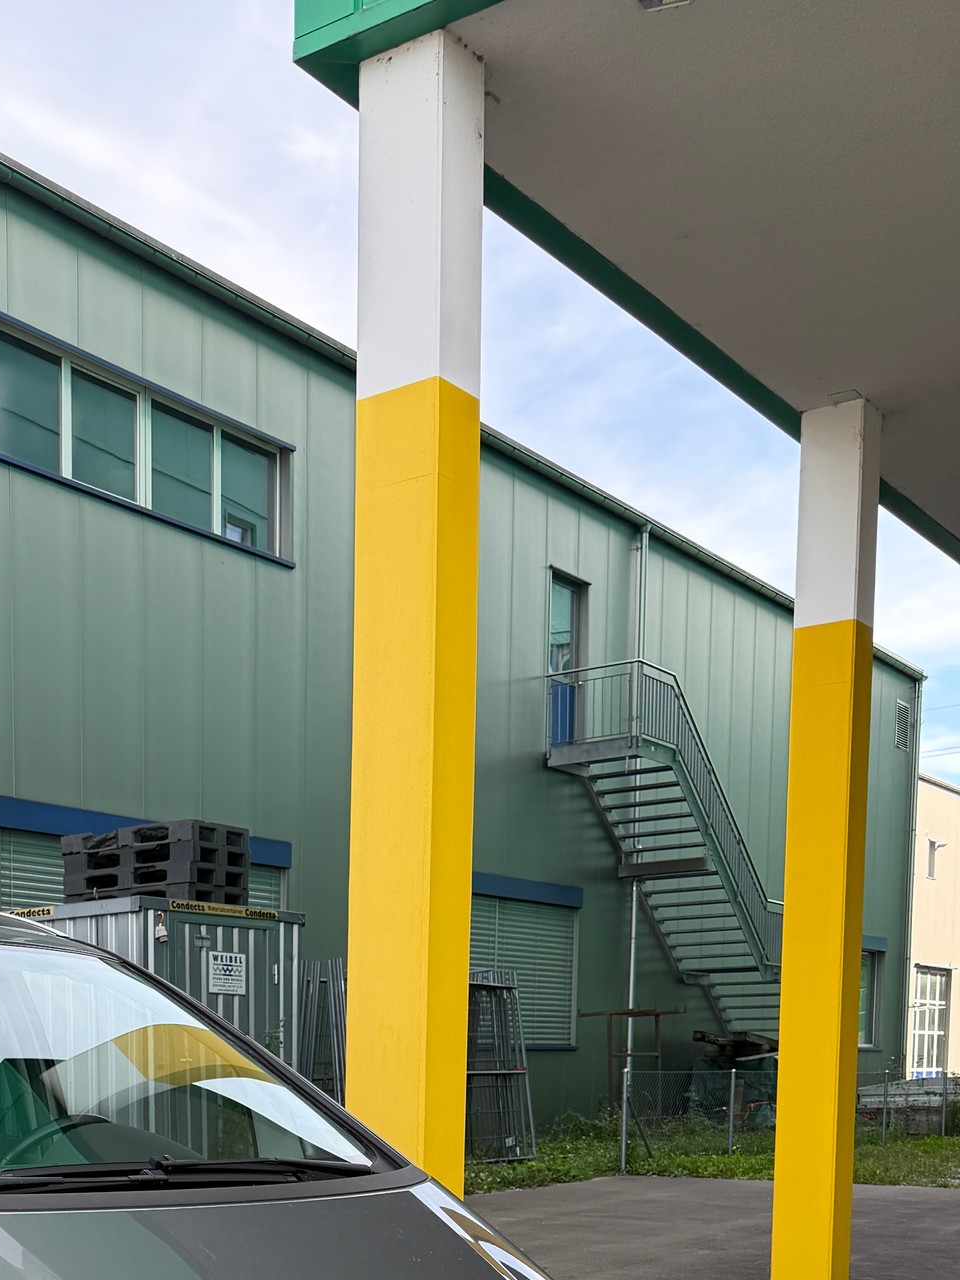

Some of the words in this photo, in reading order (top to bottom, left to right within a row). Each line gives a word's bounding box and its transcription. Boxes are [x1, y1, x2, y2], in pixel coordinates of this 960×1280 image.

[171, 901, 205, 911] Condecta
[245, 909, 276, 919] Condecta
[212, 954, 242, 964] WEIBEL
